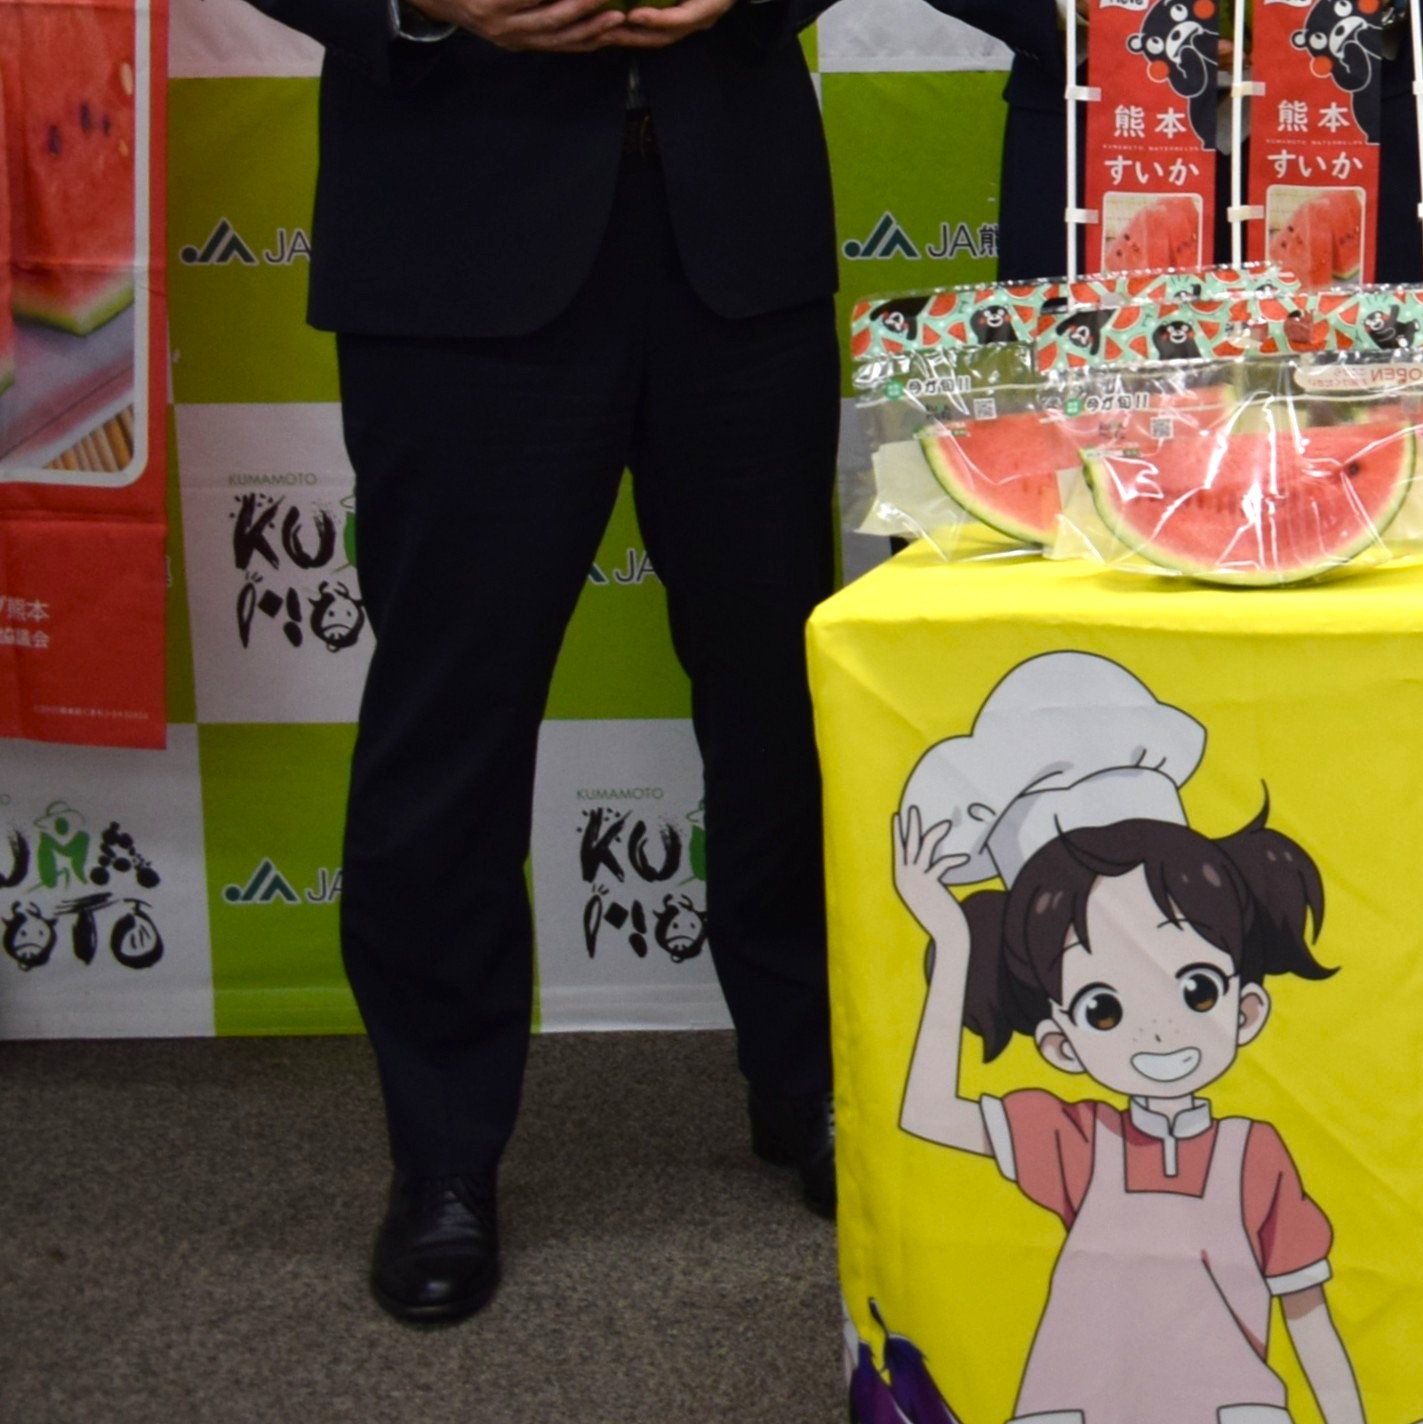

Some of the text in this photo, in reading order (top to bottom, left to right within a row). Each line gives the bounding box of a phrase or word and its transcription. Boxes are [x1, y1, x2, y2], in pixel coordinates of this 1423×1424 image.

[1114, 105, 1190, 139] 熊本
[1277, 100, 1355, 133] 熊本
[1104, 155, 1200, 186] すいか
[1267, 149, 1363, 180] すいか
[228, 473, 317, 485] KUMAMOTO
[229, 492, 356, 573] KU
[237, 572, 365, 652] MO
[577, 789, 664, 800] KUMAMOTO
[0, 801, 160, 893] UMA
[577, 800, 705, 884] KU
[2, 892, 164, 972] OTO
[584, 885, 707, 963] MO
